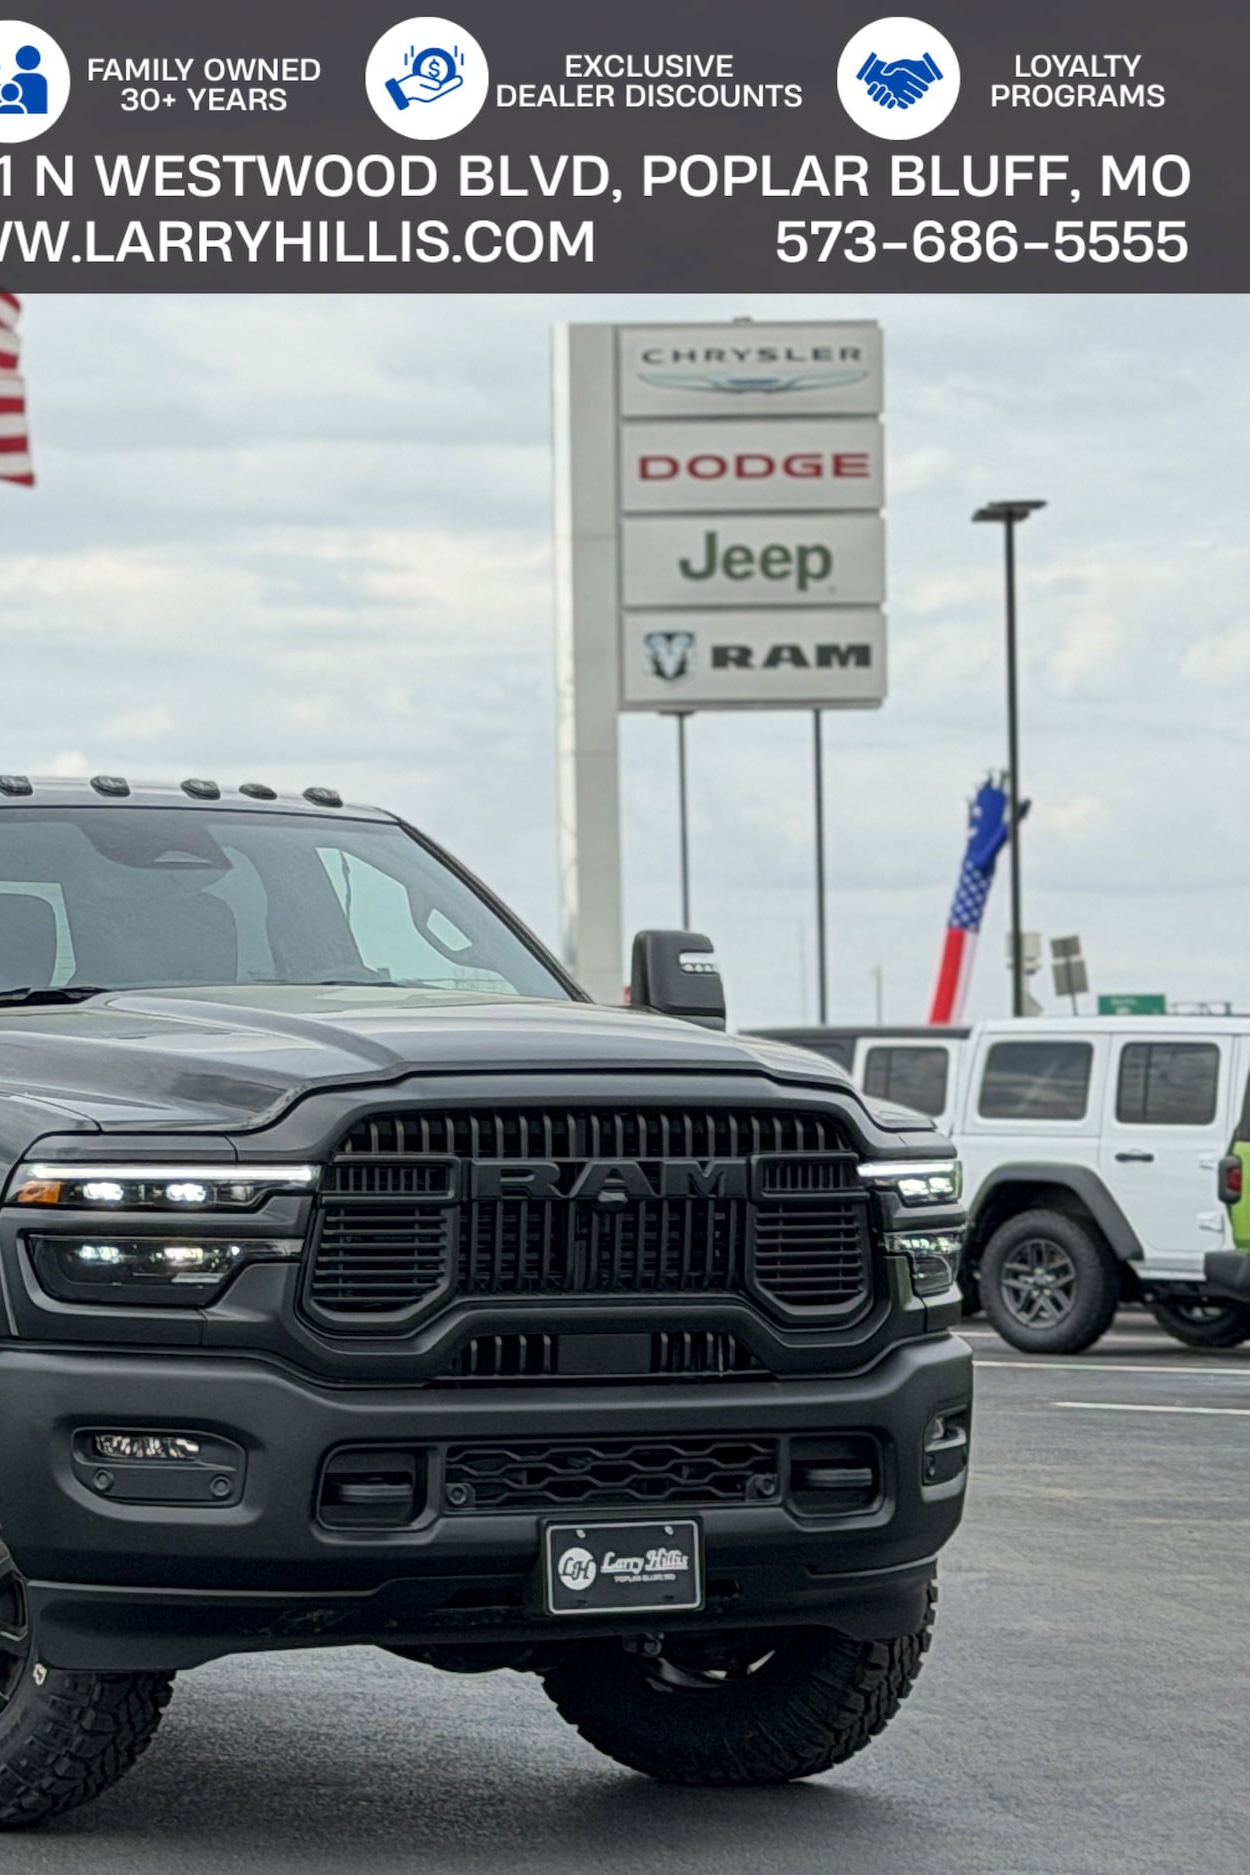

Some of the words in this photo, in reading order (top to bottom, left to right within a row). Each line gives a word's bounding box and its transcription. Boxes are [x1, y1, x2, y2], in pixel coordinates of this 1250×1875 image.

[642, 346, 862, 364] CHRYSLER
[639, 453, 870, 480] DODGE
[678, 531, 833, 591] Jeep
[711, 643, 871, 669] RAM
[472, 1159, 747, 1199] RAM
[601, 1551, 644, 1574] Larry
[645, 1547, 689, 1571] Hillis
